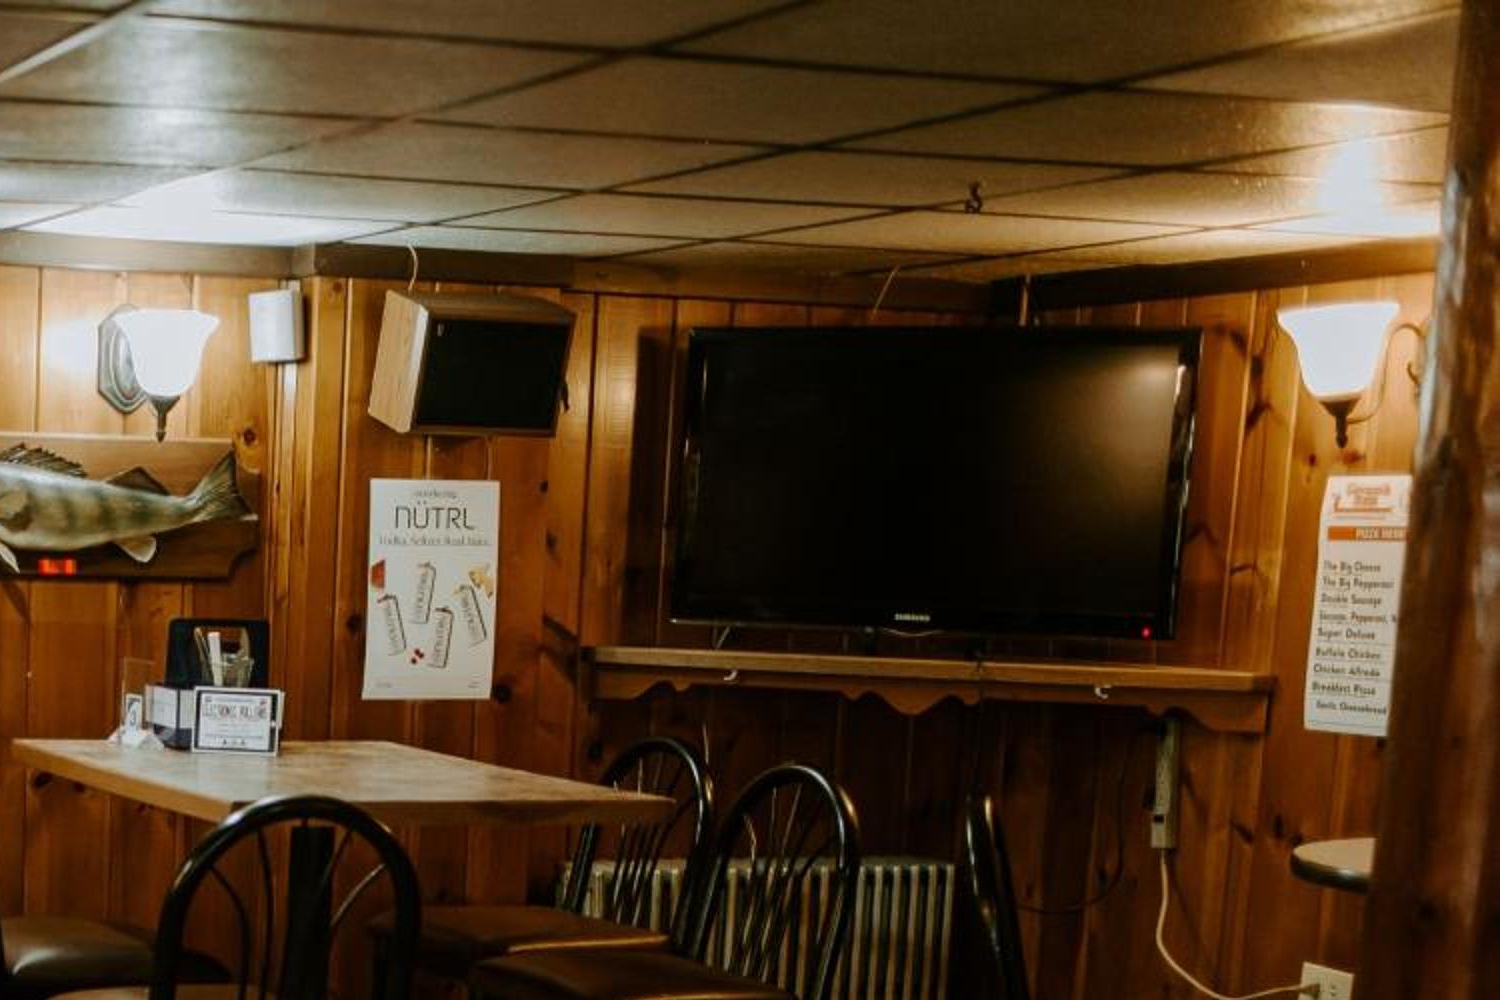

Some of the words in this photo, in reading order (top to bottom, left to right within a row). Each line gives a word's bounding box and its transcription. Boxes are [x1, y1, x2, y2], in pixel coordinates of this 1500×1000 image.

[395, 500, 475, 530] NÜTRL
[1341, 562, 1352, 574] Big
[1340, 577, 1351, 590] Big
